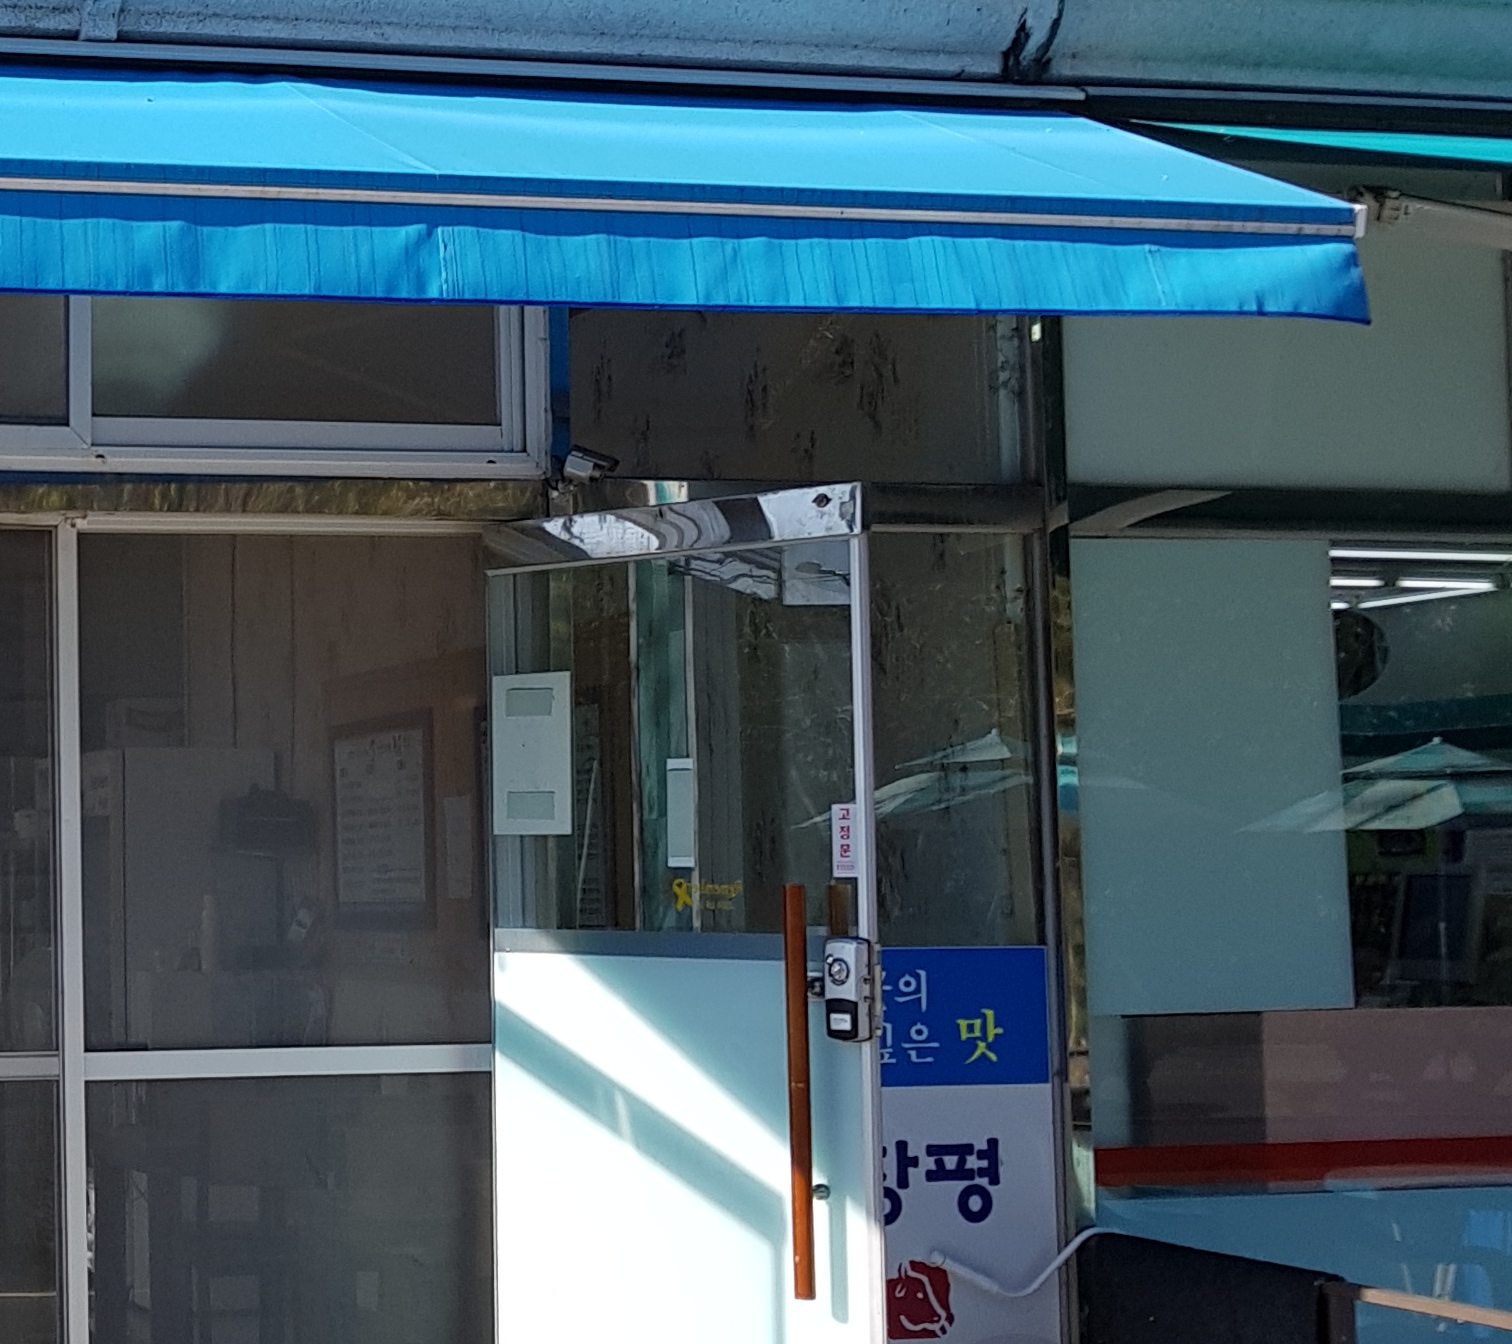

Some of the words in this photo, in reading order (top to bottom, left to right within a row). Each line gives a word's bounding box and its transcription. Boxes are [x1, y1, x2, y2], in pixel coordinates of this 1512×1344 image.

[838, 808, 851, 858] 고정문
[882, 969, 928, 1013] 의
[955, 1008, 1005, 1065] 맛
